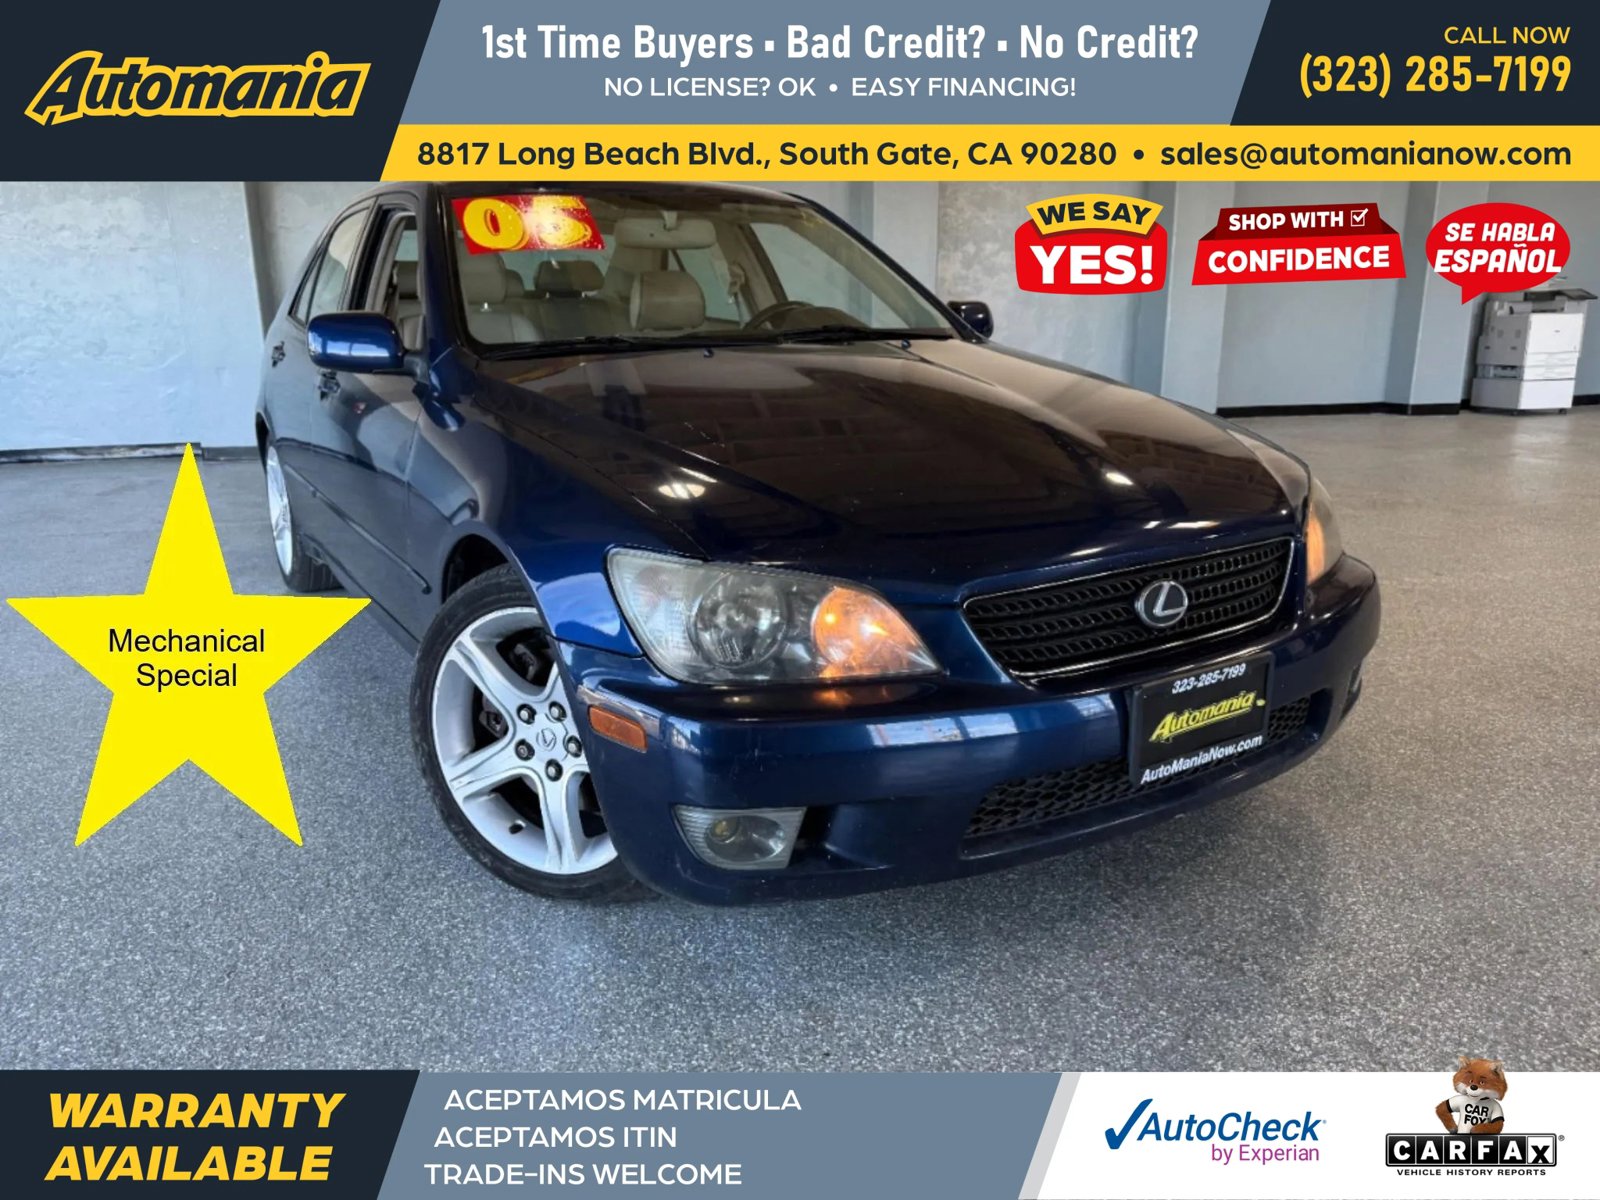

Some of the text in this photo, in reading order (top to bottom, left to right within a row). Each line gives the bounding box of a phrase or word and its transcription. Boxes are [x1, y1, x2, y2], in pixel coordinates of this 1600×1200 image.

[1172, 663, 1246, 694] 323-285-7199
[1149, 691, 1257, 742] Automania
[1140, 735, 1263, 785] AutoManiaNow.com
